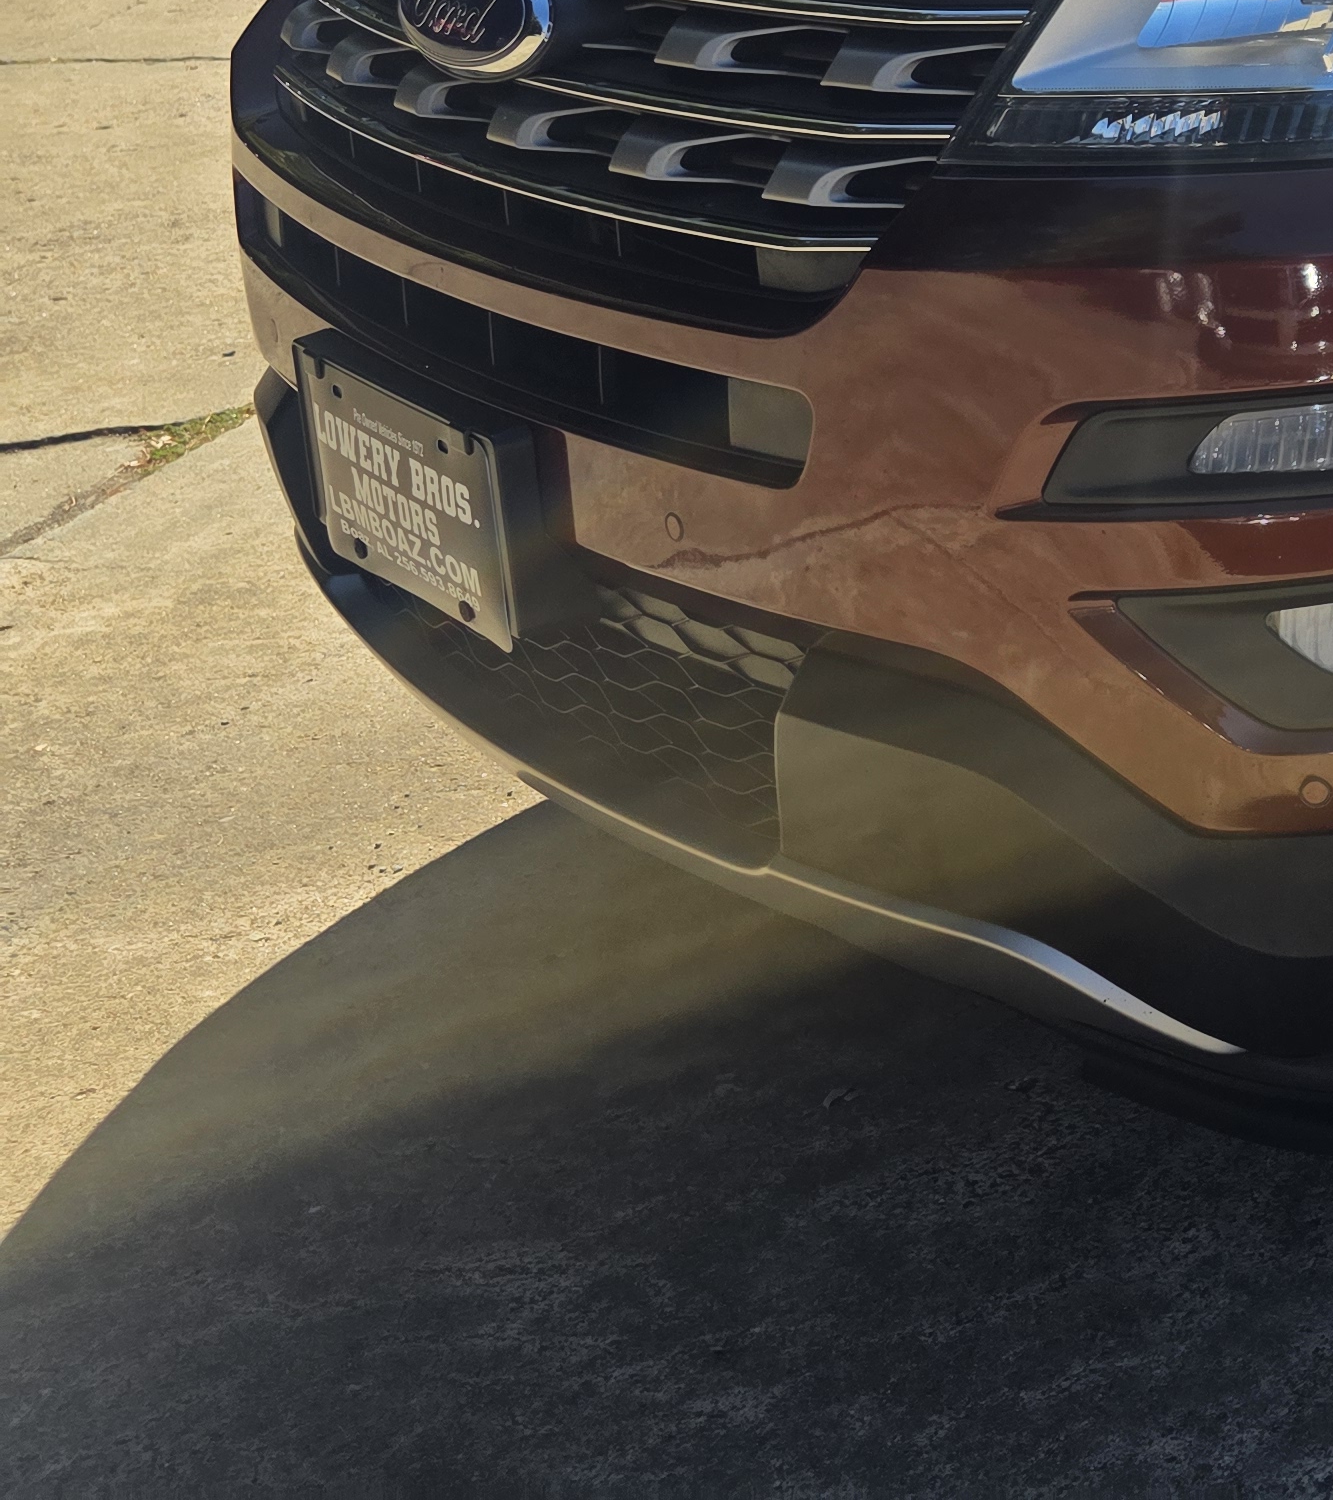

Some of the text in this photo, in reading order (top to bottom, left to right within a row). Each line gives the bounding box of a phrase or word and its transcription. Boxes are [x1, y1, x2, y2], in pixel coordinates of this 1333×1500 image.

[313, 401, 481, 529] LOWERY BROS.
[351, 466, 441, 546] MOTORS
[329, 484, 482, 597] LBMBOAZ.COM
[376, 541, 394, 561] AL
